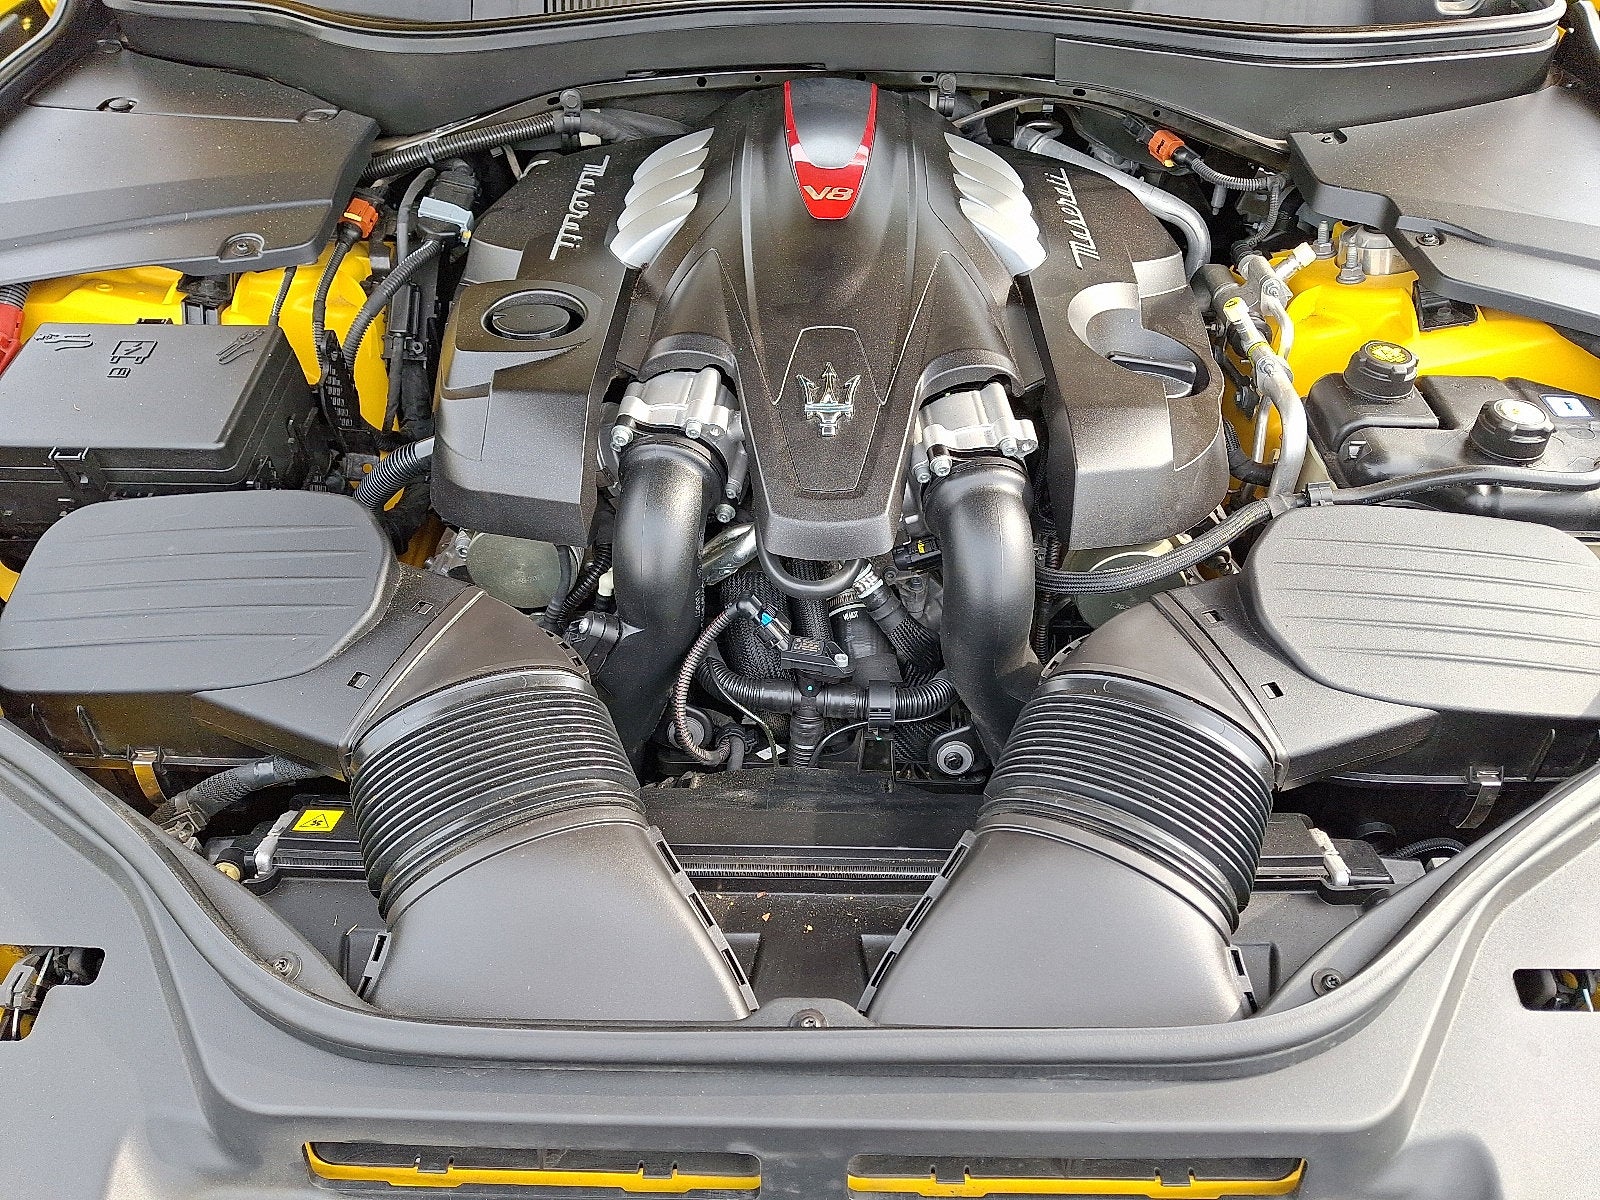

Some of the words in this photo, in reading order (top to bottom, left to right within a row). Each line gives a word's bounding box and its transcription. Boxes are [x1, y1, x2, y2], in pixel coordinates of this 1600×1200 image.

[548, 154, 611, 261] Maserati
[802, 185, 854, 201] V8
[1043, 167, 1101, 270] Maserati
